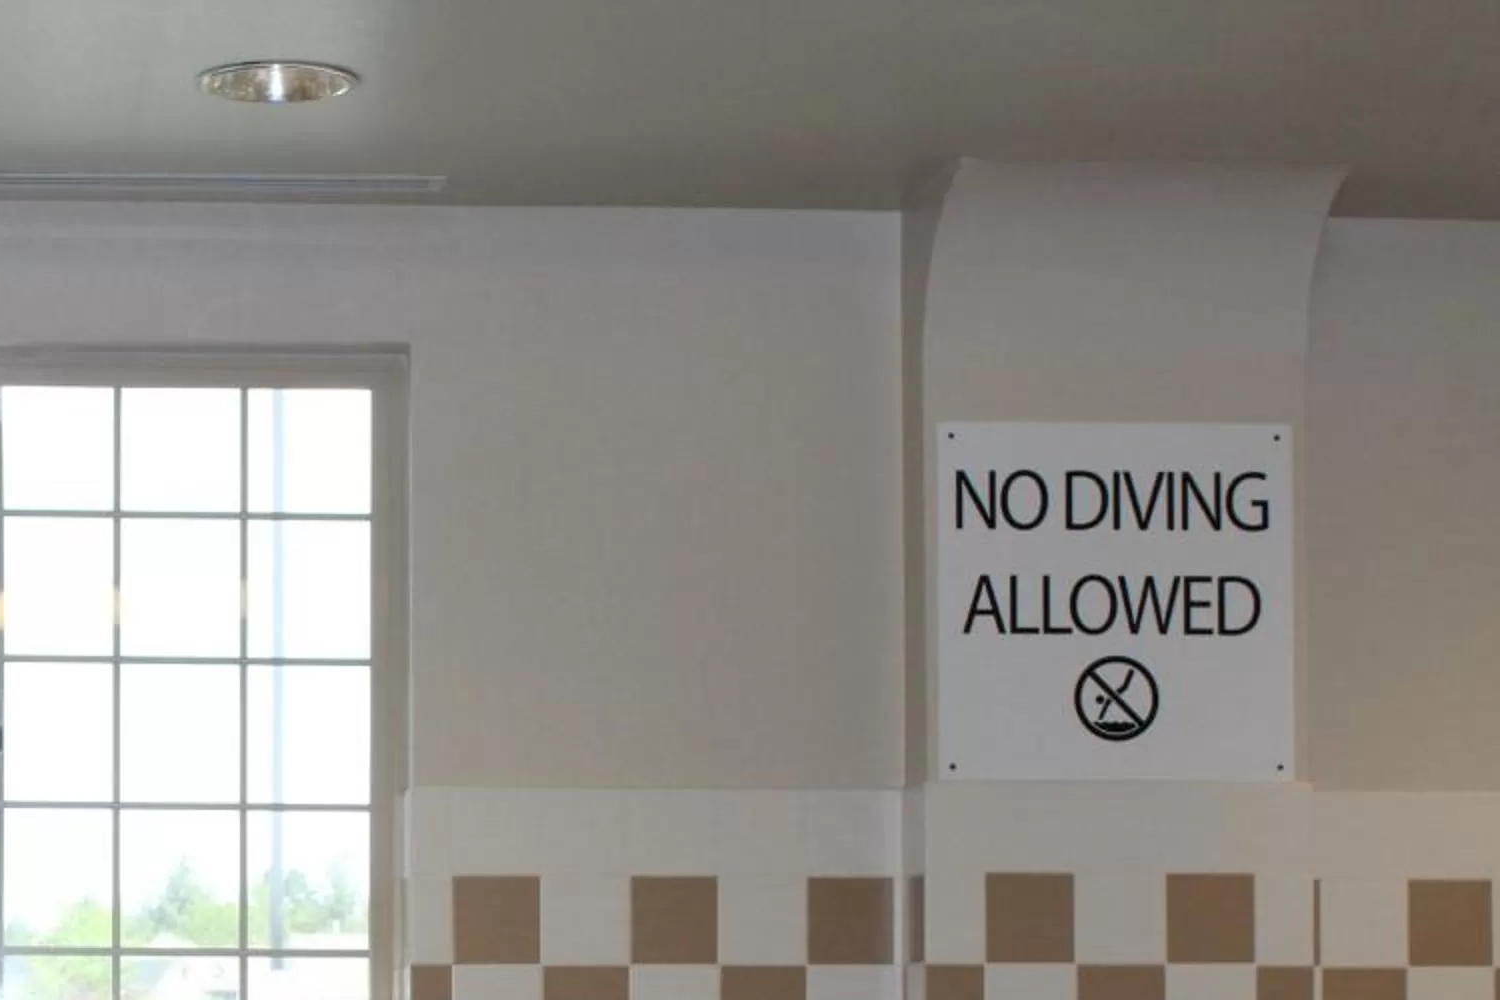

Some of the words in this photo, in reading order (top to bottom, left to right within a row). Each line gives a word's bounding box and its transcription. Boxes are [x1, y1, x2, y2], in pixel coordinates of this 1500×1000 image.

[956, 470, 1049, 530] NO
[1065, 470, 1270, 532] DIVING
[963, 574, 1262, 636] ALLOWED
